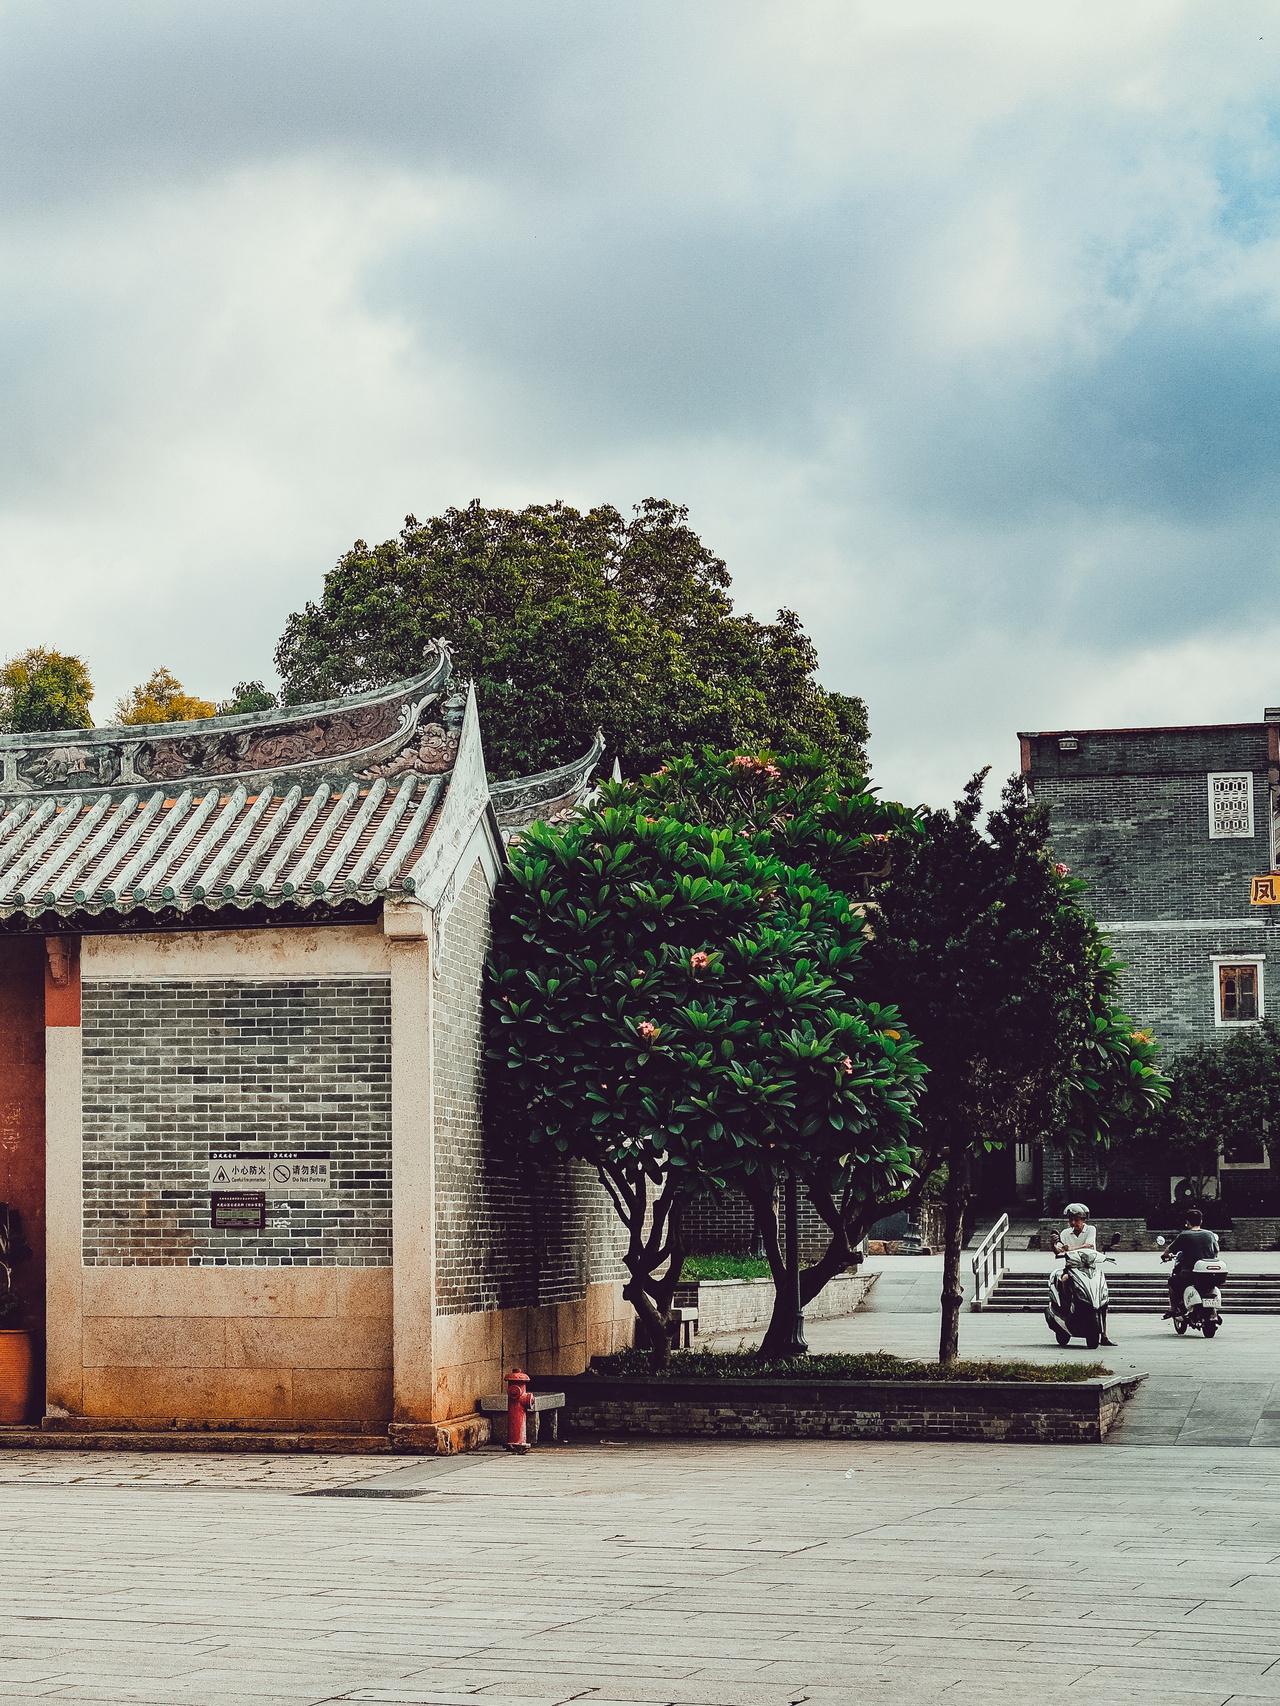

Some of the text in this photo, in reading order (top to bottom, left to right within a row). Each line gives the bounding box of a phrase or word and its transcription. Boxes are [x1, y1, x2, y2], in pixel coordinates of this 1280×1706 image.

[1254, 880, 1278, 902] 凤
[231, 1165, 266, 1175] 小心防火
[292, 1165, 327, 1175] 请勿刻画
